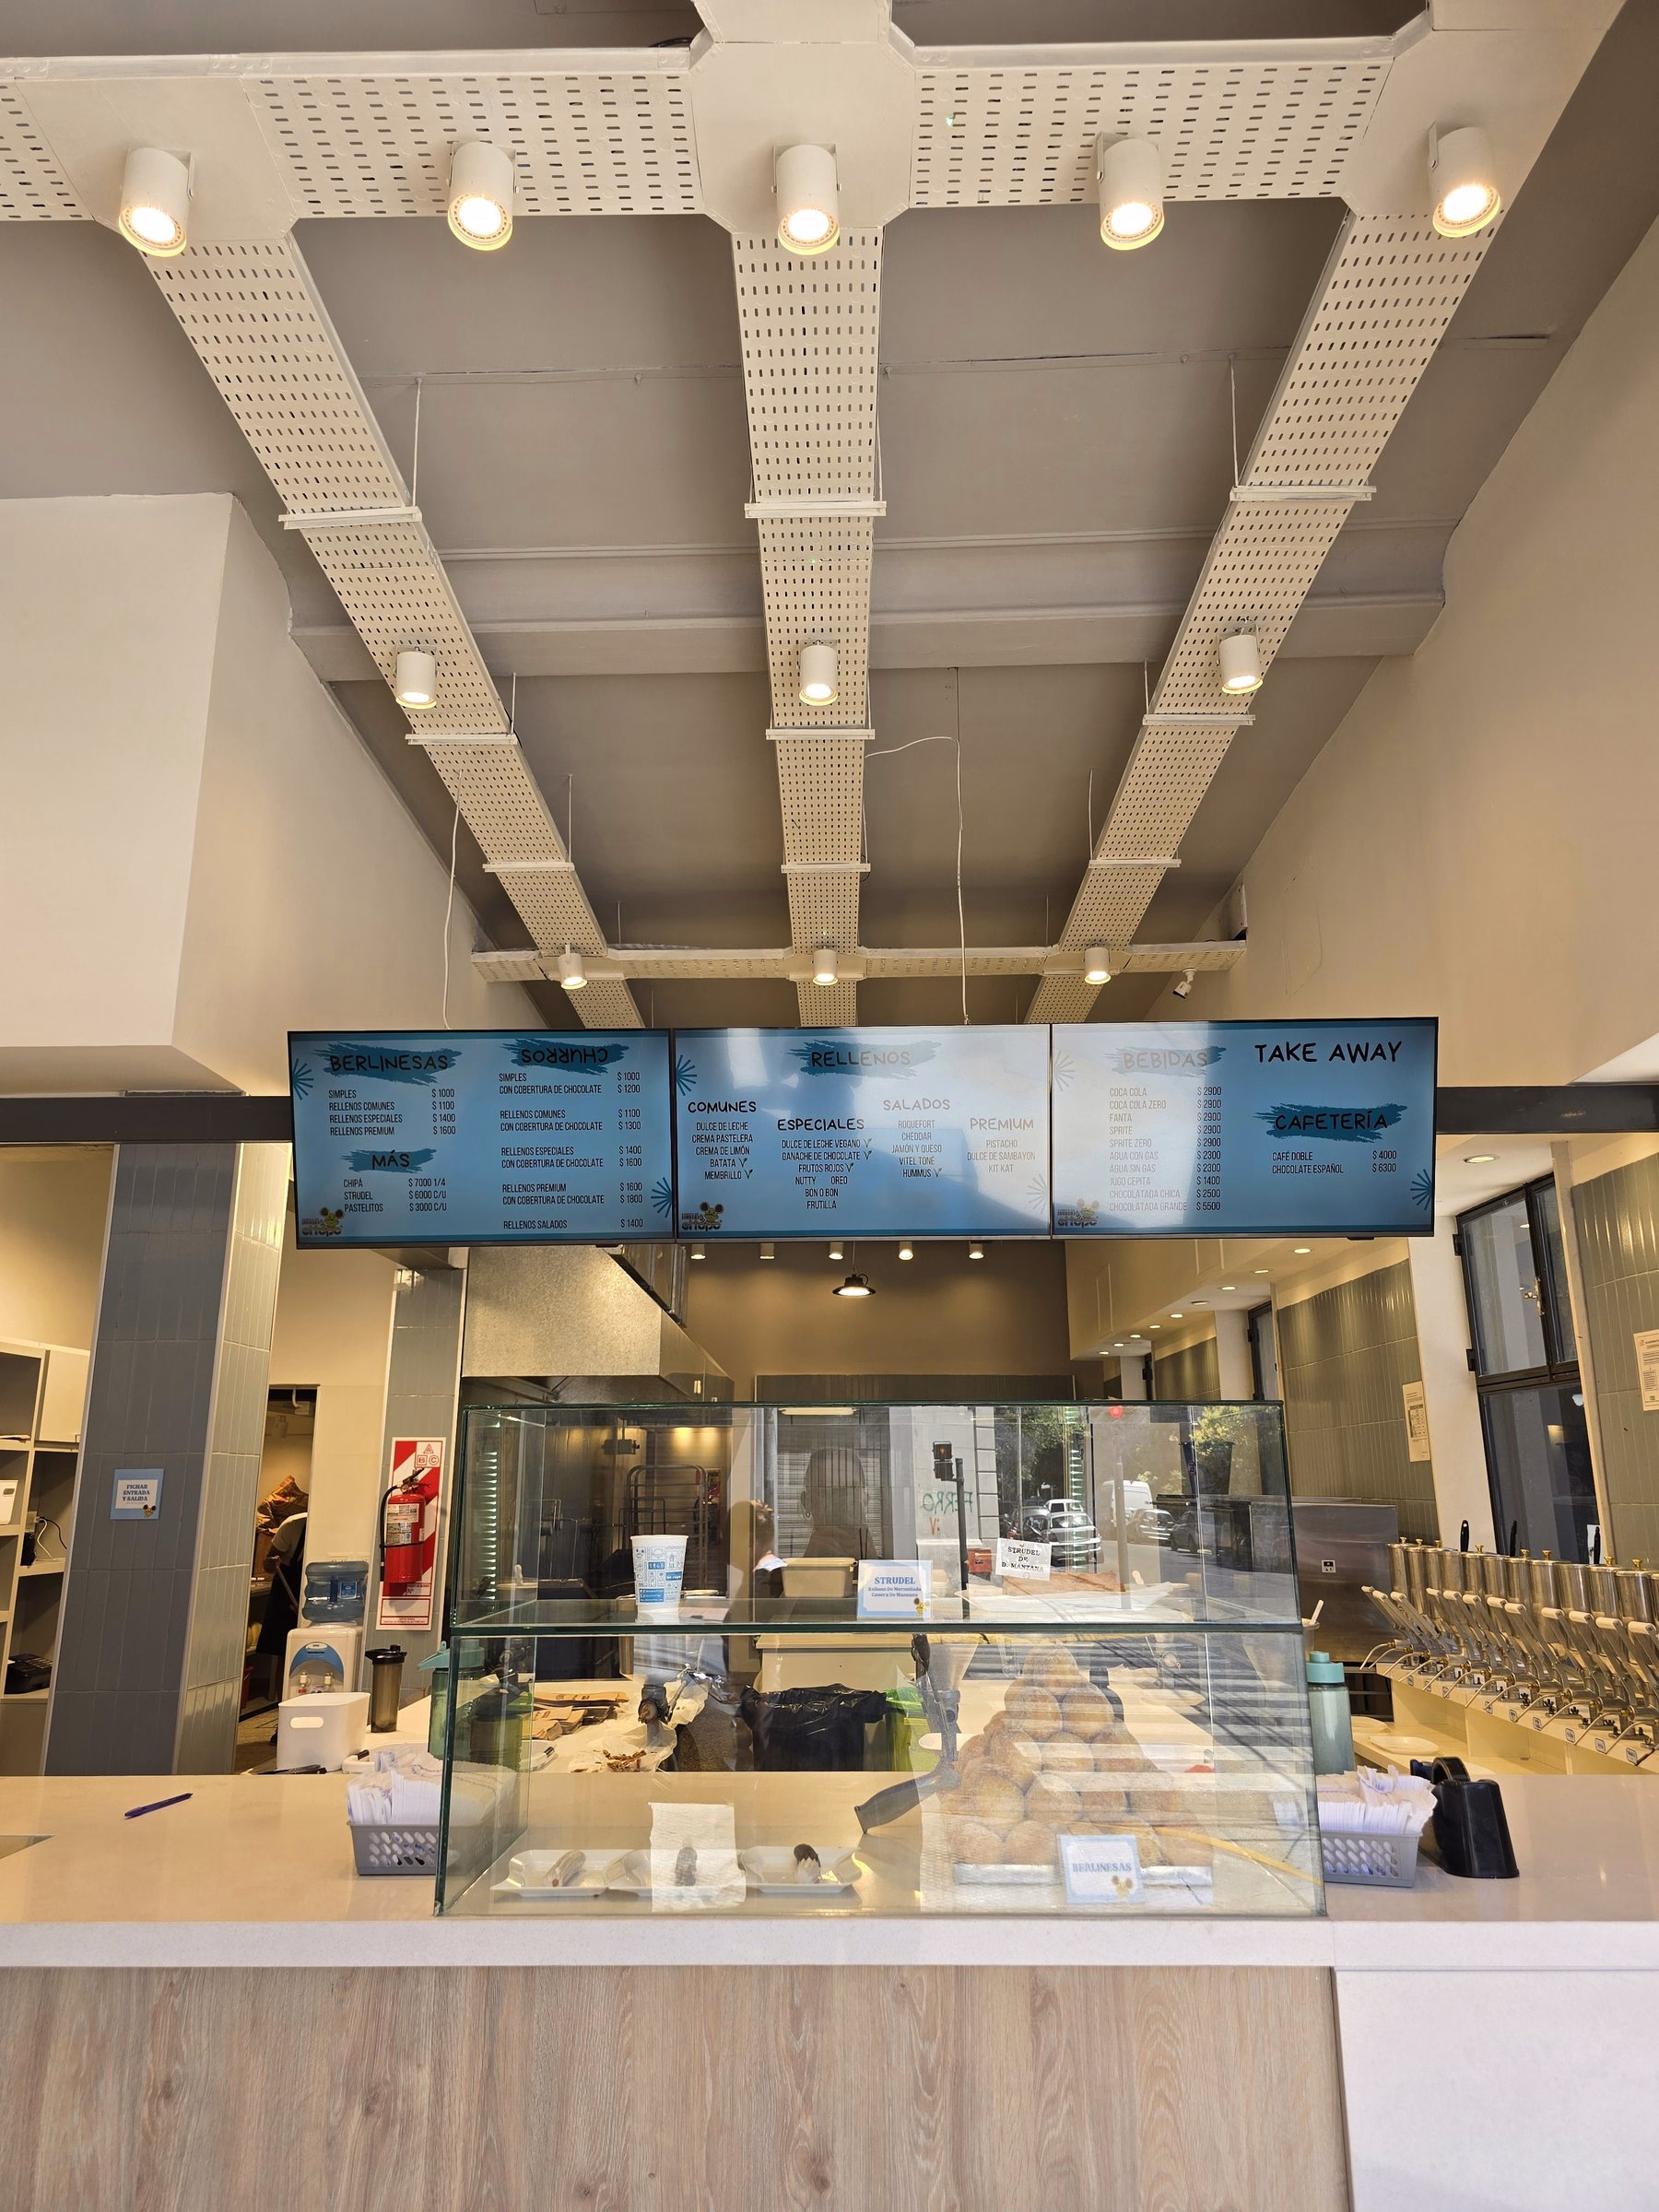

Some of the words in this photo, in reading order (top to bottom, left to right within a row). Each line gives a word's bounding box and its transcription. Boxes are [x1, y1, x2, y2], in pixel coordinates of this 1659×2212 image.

[522, 1047, 607, 1065] CHURROS
[1254, 1041, 1317, 1063] TAKE
[1329, 1041, 1402, 1063] AWAY
[330, 1055, 448, 1072] BERLINESAS
[811, 1052, 910, 1067] RELLENOS
[1124, 1052, 1208, 1069] BEBIDAS
[499, 1073, 526, 1081] SIMPLES
[624, 1072, 640, 1080] 1000
[329, 1089, 356, 1099] SIMPLES
[439, 1088, 454, 1097] 1000
[500, 1086, 512, 1094] CON
[514, 1086, 552, 1094] COBERTURA
[554, 1085, 562, 1094] DE
[564, 1085, 601, 1094] CHOCOLATE
[625, 1085, 640, 1093] 1200
[1110, 1088, 1127, 1097] COCA
[1129, 1088, 1147, 1097] COLA
[1204, 1087, 1221, 1095] 2900
[329, 1102, 362, 1111] RELLENOS
[439, 1101, 454, 1110] 1100
[688, 1101, 756, 1114] COMUNES
[883, 1099, 950, 1111] SALADOS
[1110, 1101, 1127, 1110] COCA
[1148, 1100, 1166, 1109] ZERO
[1204, 1100, 1221, 1108] 2900
[364, 1114, 403, 1123] ESPECIALES
[440, 1113, 455, 1122] 1400
[500, 1111, 533, 1119] RELLENOS
[535, 1110, 565, 1118] COMUNES
[625, 1109, 640, 1117] 1100
[1110, 1113, 1132, 1123] FANTA
[1204, 1112, 1221, 1121] 2900
[778, 1118, 864, 1131] ESPECIALES
[899, 1120, 935, 1129] ROQUEFORT
[970, 1118, 1033, 1131] PREMIUM
[1276, 1111, 1387, 1130] CAFETERÍA
[330, 1127, 363, 1135] RELLENOS
[440, 1126, 455, 1135] 1600
[697, 1123, 717, 1131] DULCE
[718, 1122, 726, 1130] DE
[728, 1122, 747, 1130] LECHE
[1110, 1126, 1133, 1135] SPRITE
[1204, 1125, 1221, 1134] 2900
[692, 1135, 714, 1143] CREMA
[716, 1135, 753, 1143] PASTELERA
[901, 1132, 932, 1140] CHEDDAR
[782, 1140, 802, 1148] DULCE
[804, 1139, 812, 1148] DE
[814, 1139, 833, 1148] LECHE
[835, 1139, 860, 1147] VEGANO
[986, 1139, 1018, 1148] PISTACHO
[1110, 1139, 1133, 1147] SPRITE
[1135, 1139, 1151, 1147] ZERO
[1204, 1138, 1221, 1147] 2900
[501, 1147, 534, 1156] RELLENOS
[535, 1147, 573, 1155] ESPECIALES
[626, 1146, 641, 1154] 1400
[696, 1147, 718, 1155] CREMA
[720, 1147, 728, 1155] DE
[730, 1146, 749, 1155] LIMÓN
[892, 1144, 914, 1153] JAMÓN
[372, 1149, 409, 1170] MÁS
[782, 1152, 812, 1160] GANACHE
[814, 1152, 822, 1160] DE
[823, 1151, 860, 1160] CHOCOLATE
[968, 1152, 987, 1160] DULCE
[989, 1152, 997, 1160] DE
[1110, 1152, 1127, 1160] AGUA
[1129, 1152, 1143, 1160] CON
[1145, 1151, 1158, 1160] GAS
[1204, 1151, 1221, 1159] 2300
[1273, 1150, 1289, 1160] CAFÉ
[1291, 1152, 1312, 1160] DOBLE
[1379, 1150, 1396, 1159] 4000
[501, 1159, 515, 1168] CON
[516, 1159, 554, 1168] COBERTURA
[556, 1159, 564, 1168] DE
[566, 1159, 603, 1167] CHOCOLATE
[710, 1159, 735, 1167] BATATA
[900, 1157, 917, 1165] VITEL
[799, 1164, 823, 1172] FRUTOS
[825, 1164, 843, 1172] ROJOS
[989, 1164, 999, 1172] KIT
[1001, 1164, 1014, 1172] KAT
[1110, 1165, 1128, 1173] AGUA
[1130, 1164, 1141, 1172] SIN
[1142, 1164, 1156, 1172] GAS
[1204, 1164, 1221, 1172] 2300
[1273, 1164, 1312, 1173] CHOCOLATE
[1313, 1163, 1344, 1173] ESPAÑOL
[705, 1171, 741, 1180] MEMBRILLO
[903, 1169, 931, 1177] HUMMUS
[344, 1178, 363, 1187] CHIPÁ
[416, 1179, 431, 1187] 7000
[434, 1178, 445, 1186] 1/4
[795, 1176, 816, 1184] NUTTY
[831, 1176, 847, 1184] OREO
[1110, 1178, 1125, 1186] JUGO
[1204, 1177, 1220, 1185] 1400
[502, 1183, 535, 1193] RELLENOS
[536, 1183, 566, 1192] PREMIUM
[627, 1182, 642, 1191] 1600
[806, 1189, 818, 1197] BON
[826, 1188, 838, 1196] BON
[345, 1204, 383, 1212] PASTELITOS
[416, 1203, 432, 1211] 3000
[434, 1203, 446, 1211] C/U
[807, 1201, 837, 1209] FRUTILLA
[1110, 1203, 1159, 1211] CHOCOLATADA
[1160, 1202, 1187, 1211] GRANDE
[1203, 1202, 1220, 1211] 5500
[503, 1220, 536, 1230] RELLENOS
[537, 1220, 567, 1229] SALADOS
[628, 1219, 642, 1228] 1400
[1008, 1547, 1040, 1556] STRUDEL
[1073, 1863, 1132, 1872] BERLINESAS
